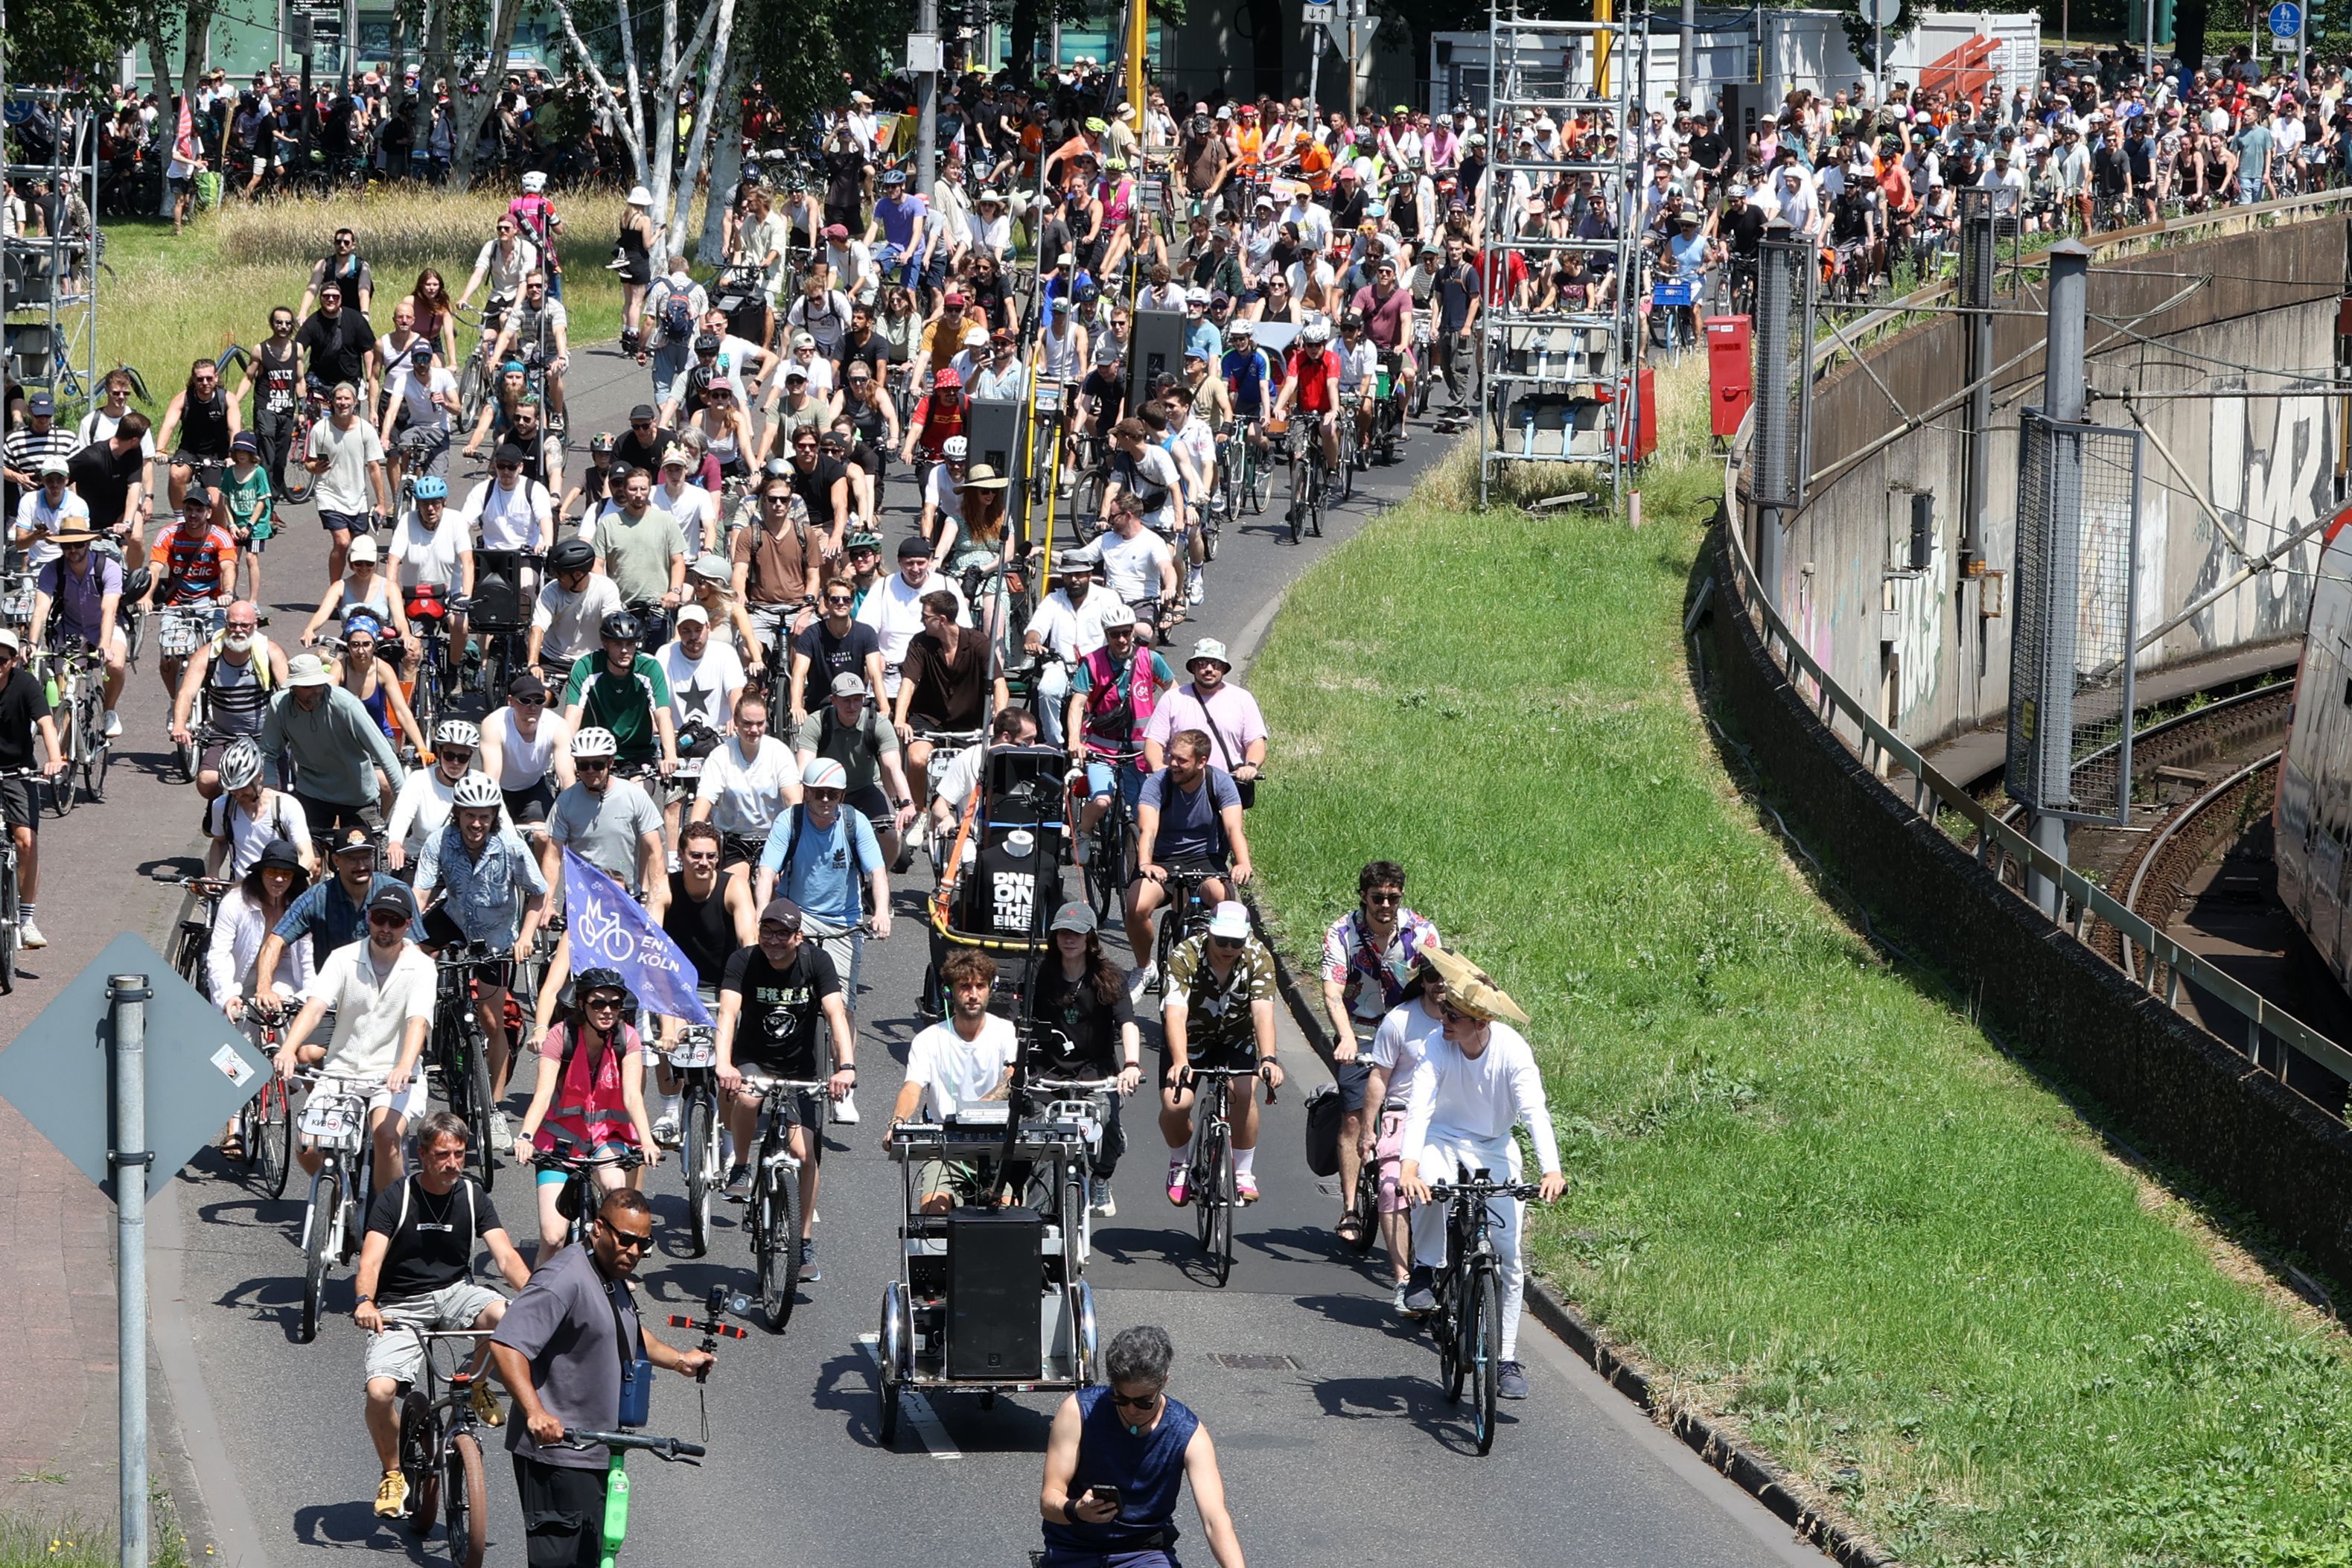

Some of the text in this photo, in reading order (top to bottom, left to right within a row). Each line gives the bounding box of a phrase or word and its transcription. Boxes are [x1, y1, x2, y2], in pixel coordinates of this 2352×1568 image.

[268, 369, 293, 380] ONLY
[270, 389, 290, 399] CAN
[994, 883, 1033, 905] ON
[993, 902, 1033, 917] THE
[993, 914, 1032, 928] BIKE
[637, 952, 680, 973] KÖLN
[681, 1052, 695, 1060] KVB
[311, 1118, 327, 1127] KVB
[896, 1123, 943, 1132] @domwhiting
